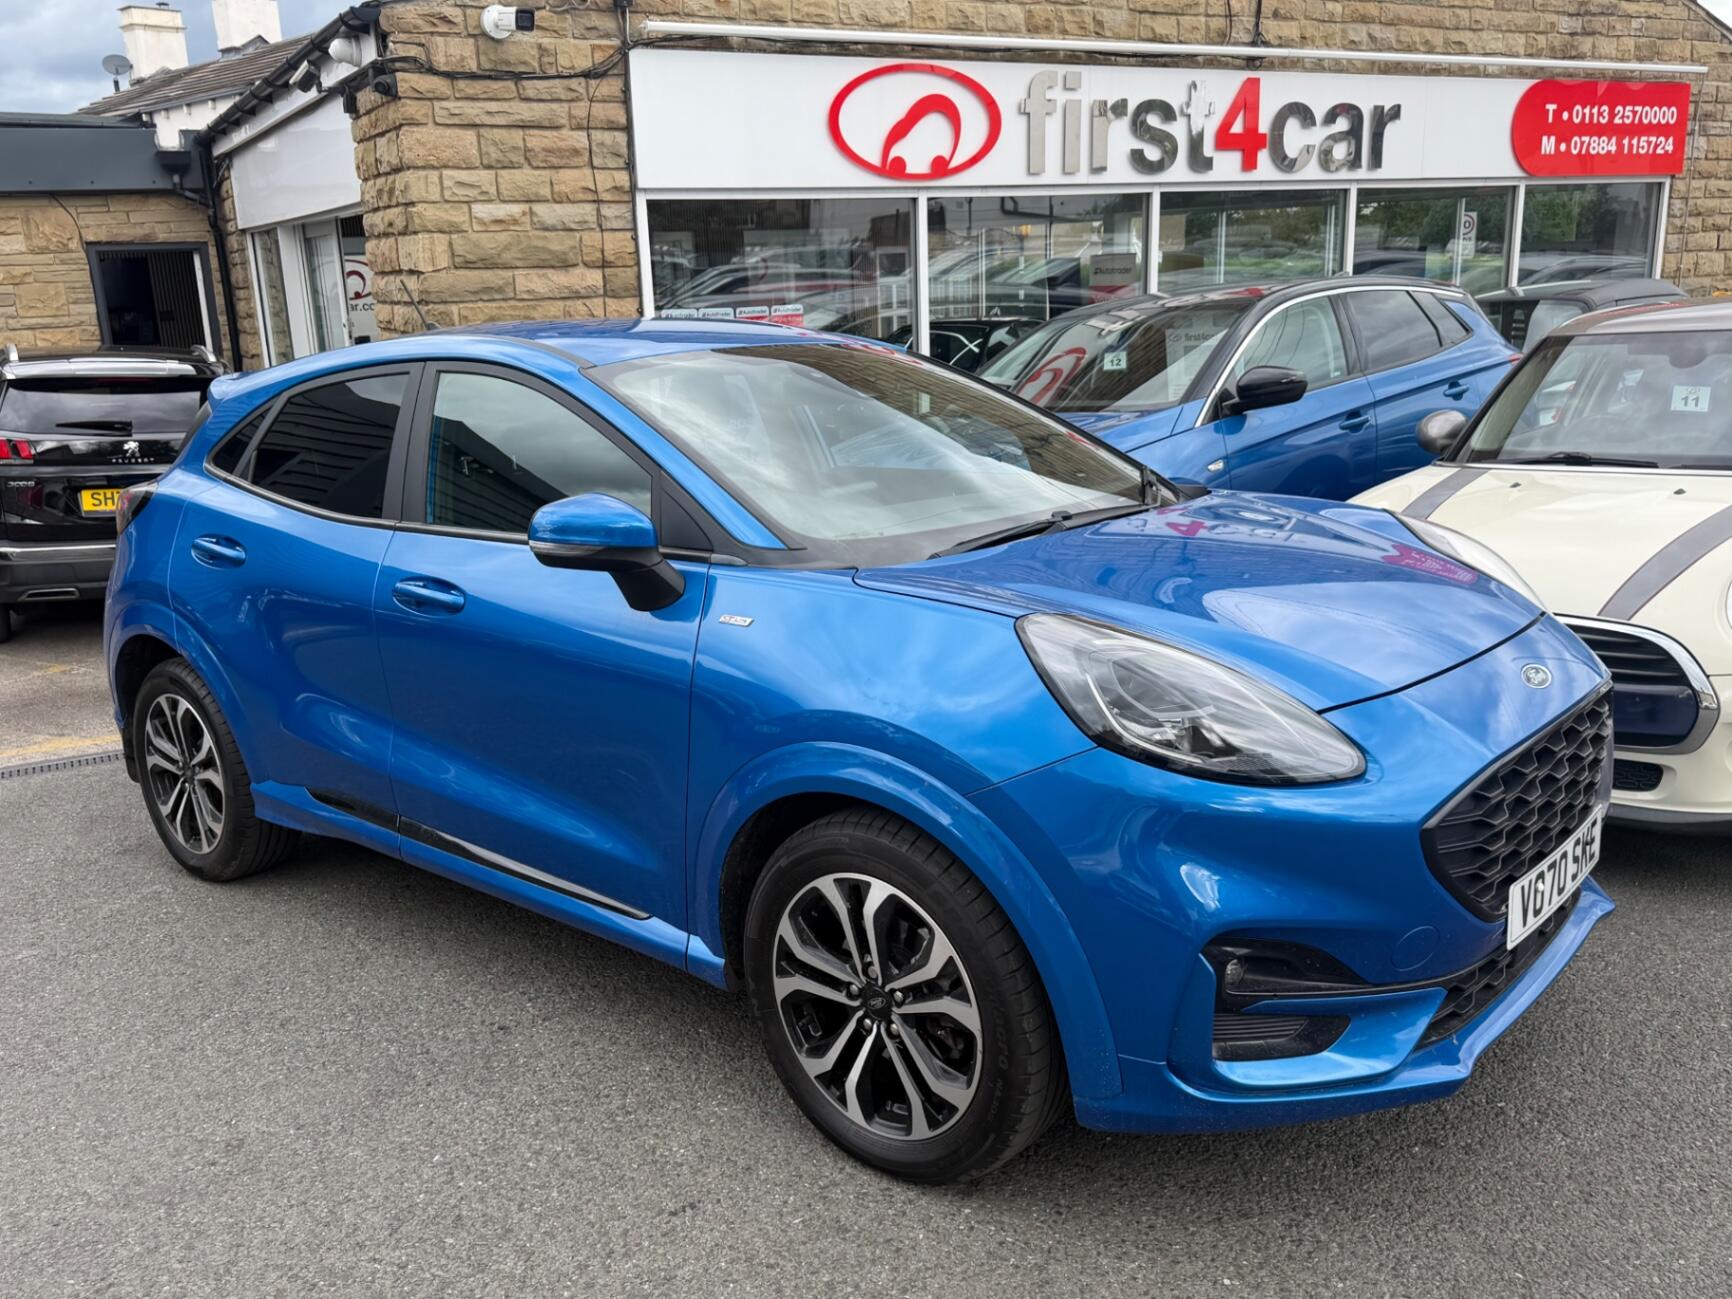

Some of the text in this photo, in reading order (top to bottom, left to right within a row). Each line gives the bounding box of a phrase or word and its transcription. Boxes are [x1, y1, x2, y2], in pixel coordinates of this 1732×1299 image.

[1020, 71, 1402, 175] first4car
[1545, 104, 1677, 125] T 0113 2570000
[1541, 136, 1674, 155] M 07884 115724
[1109, 358, 1122, 367] 12
[1681, 395, 1700, 408] 11
[1571, 817, 1598, 883] SKE
